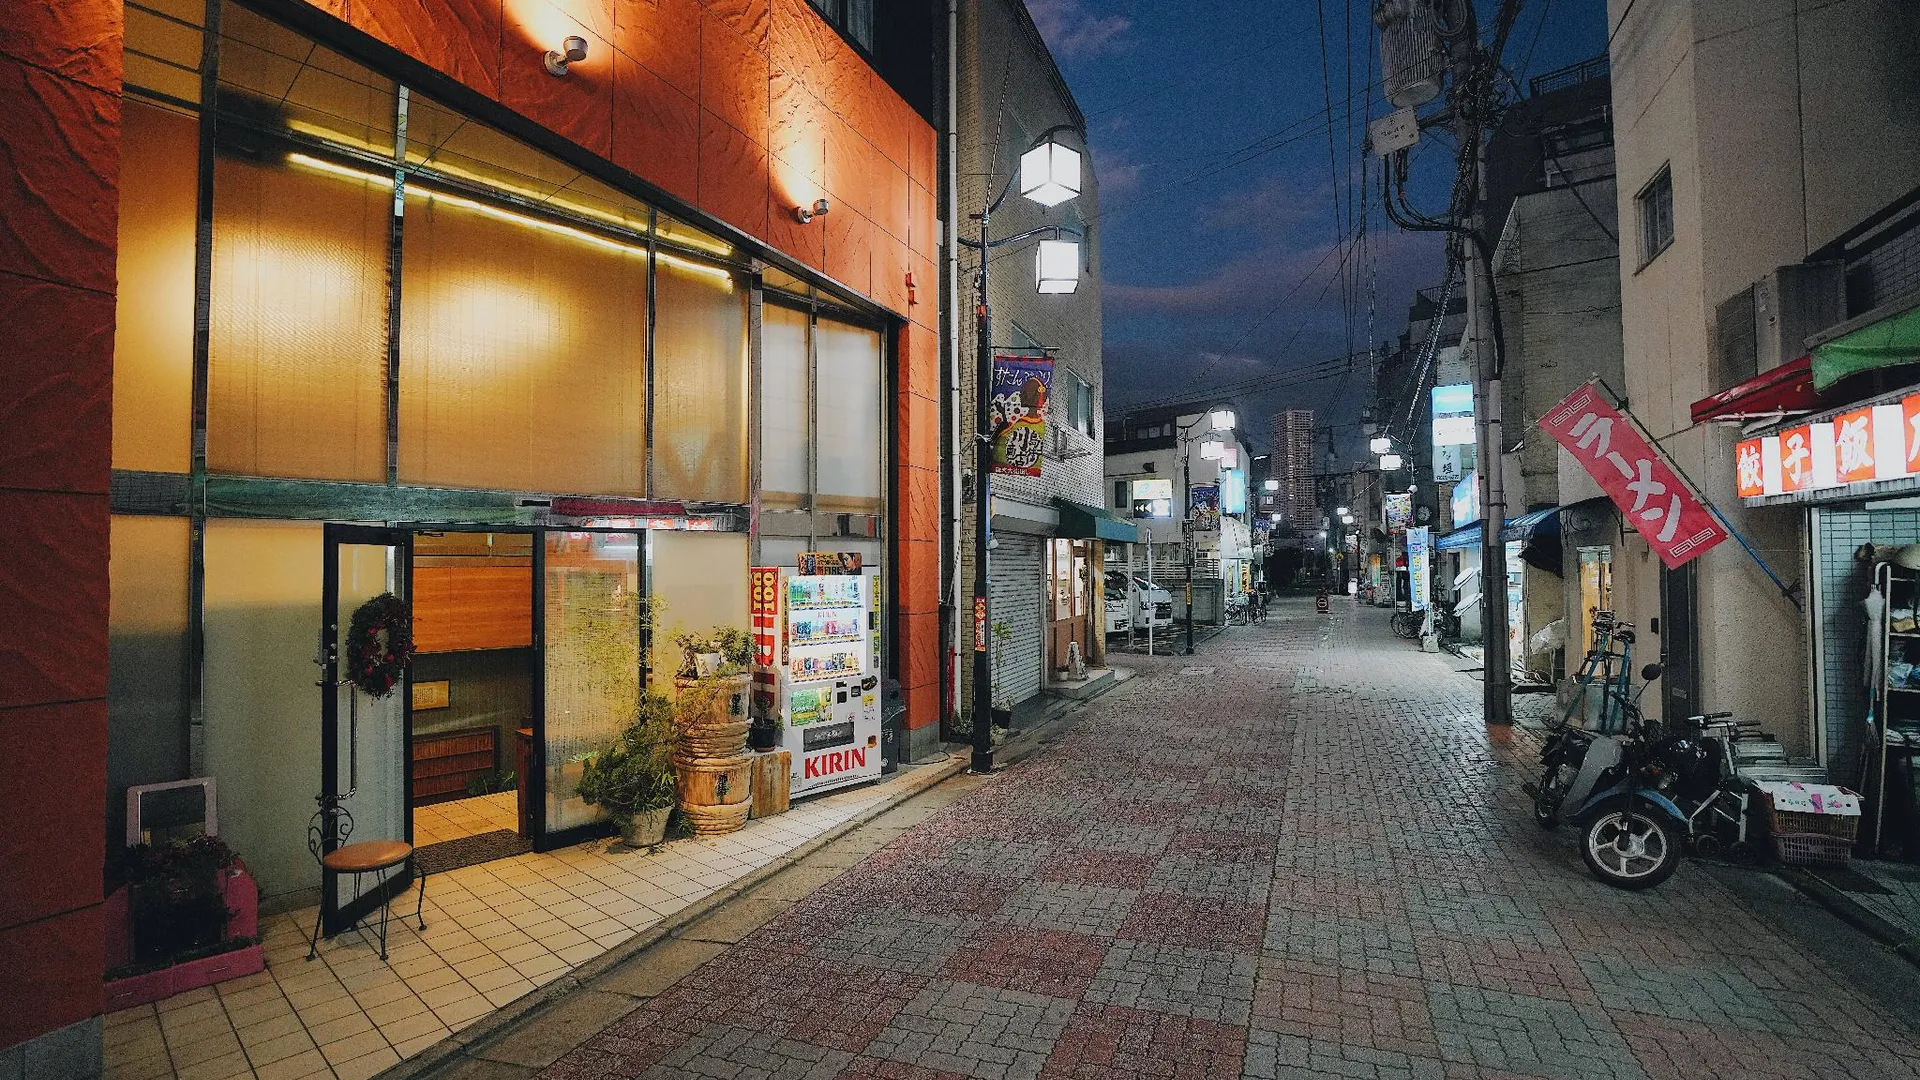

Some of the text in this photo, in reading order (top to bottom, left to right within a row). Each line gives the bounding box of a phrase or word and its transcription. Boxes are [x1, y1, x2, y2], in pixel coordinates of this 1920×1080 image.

[1569, 412, 1682, 543] ラーメン
[804, 746, 866, 780] KIRIN
